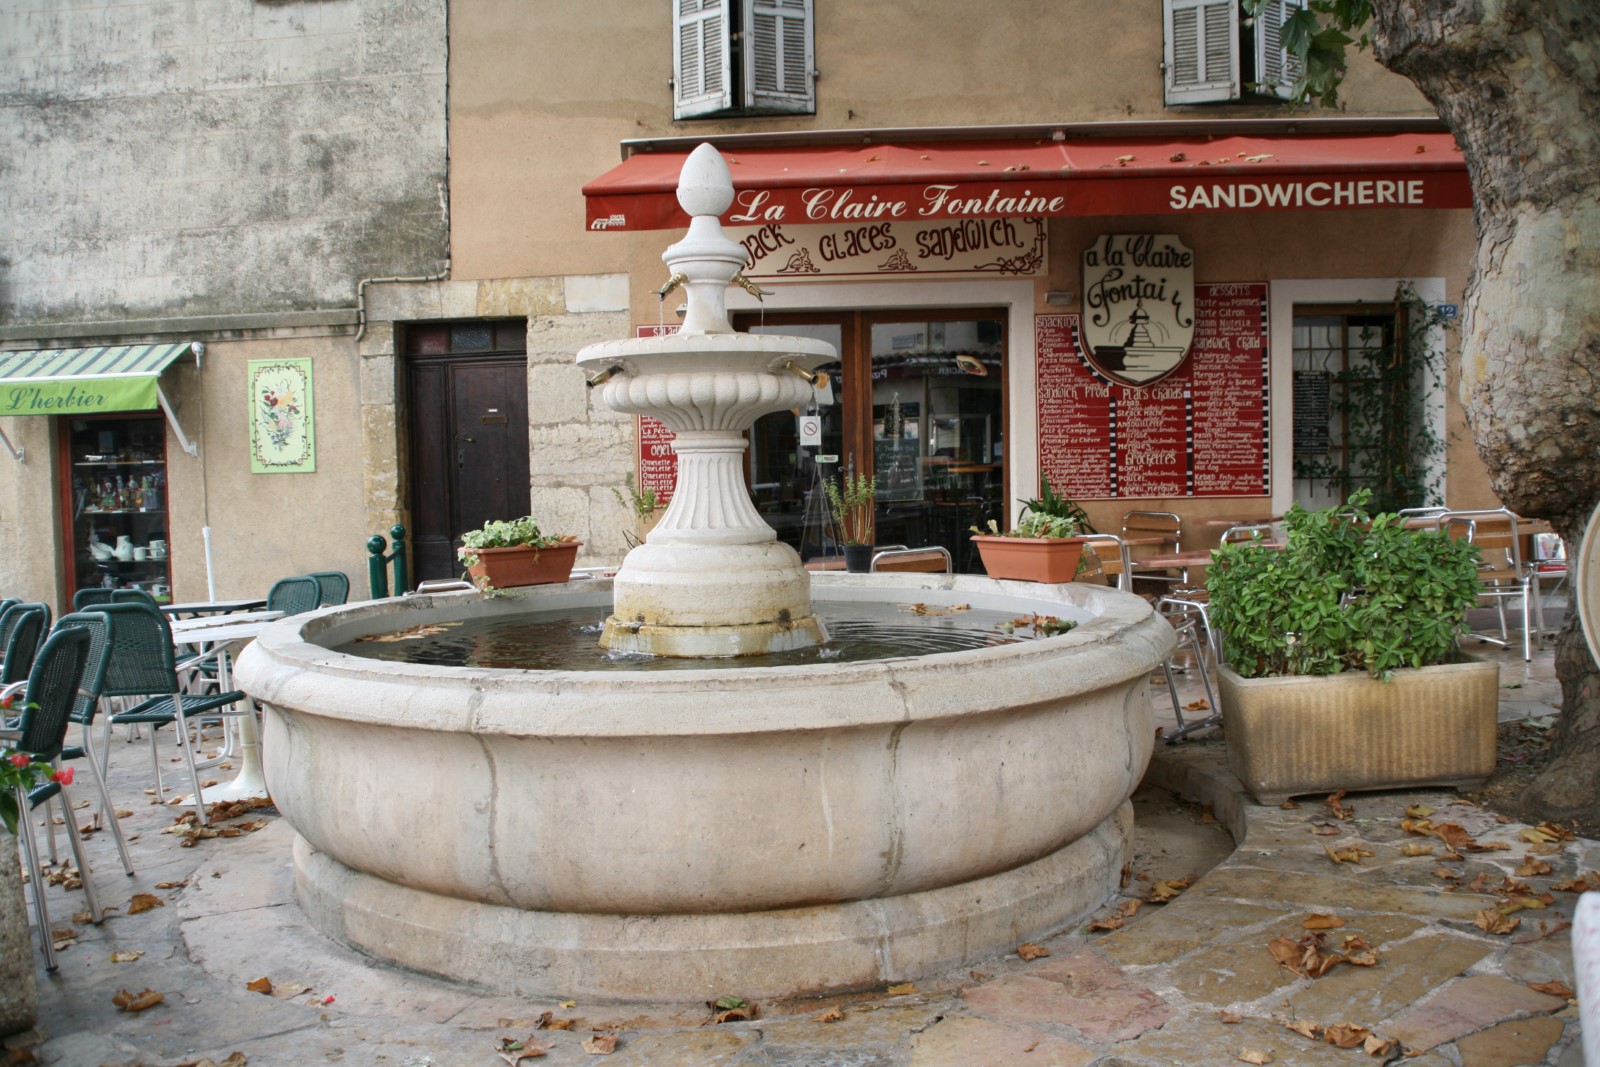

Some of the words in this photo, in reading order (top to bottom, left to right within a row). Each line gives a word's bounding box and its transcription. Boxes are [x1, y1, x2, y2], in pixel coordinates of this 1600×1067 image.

[730, 190, 785, 222] La
[801, 188, 907, 220] Claire
[918, 184, 1065, 216] Fontaine
[1169, 180, 1424, 210] SANDWICHERIE
[1086, 250, 1100, 266] a
[1102, 234, 1125, 266] la
[1126, 234, 1192, 268] Claire
[1195, 309, 1218, 317] Tarte
[1218, 309, 1246, 317] Citron
[1440, 306, 1454, 316] 12
[5, 386, 110, 410] L'herbier
